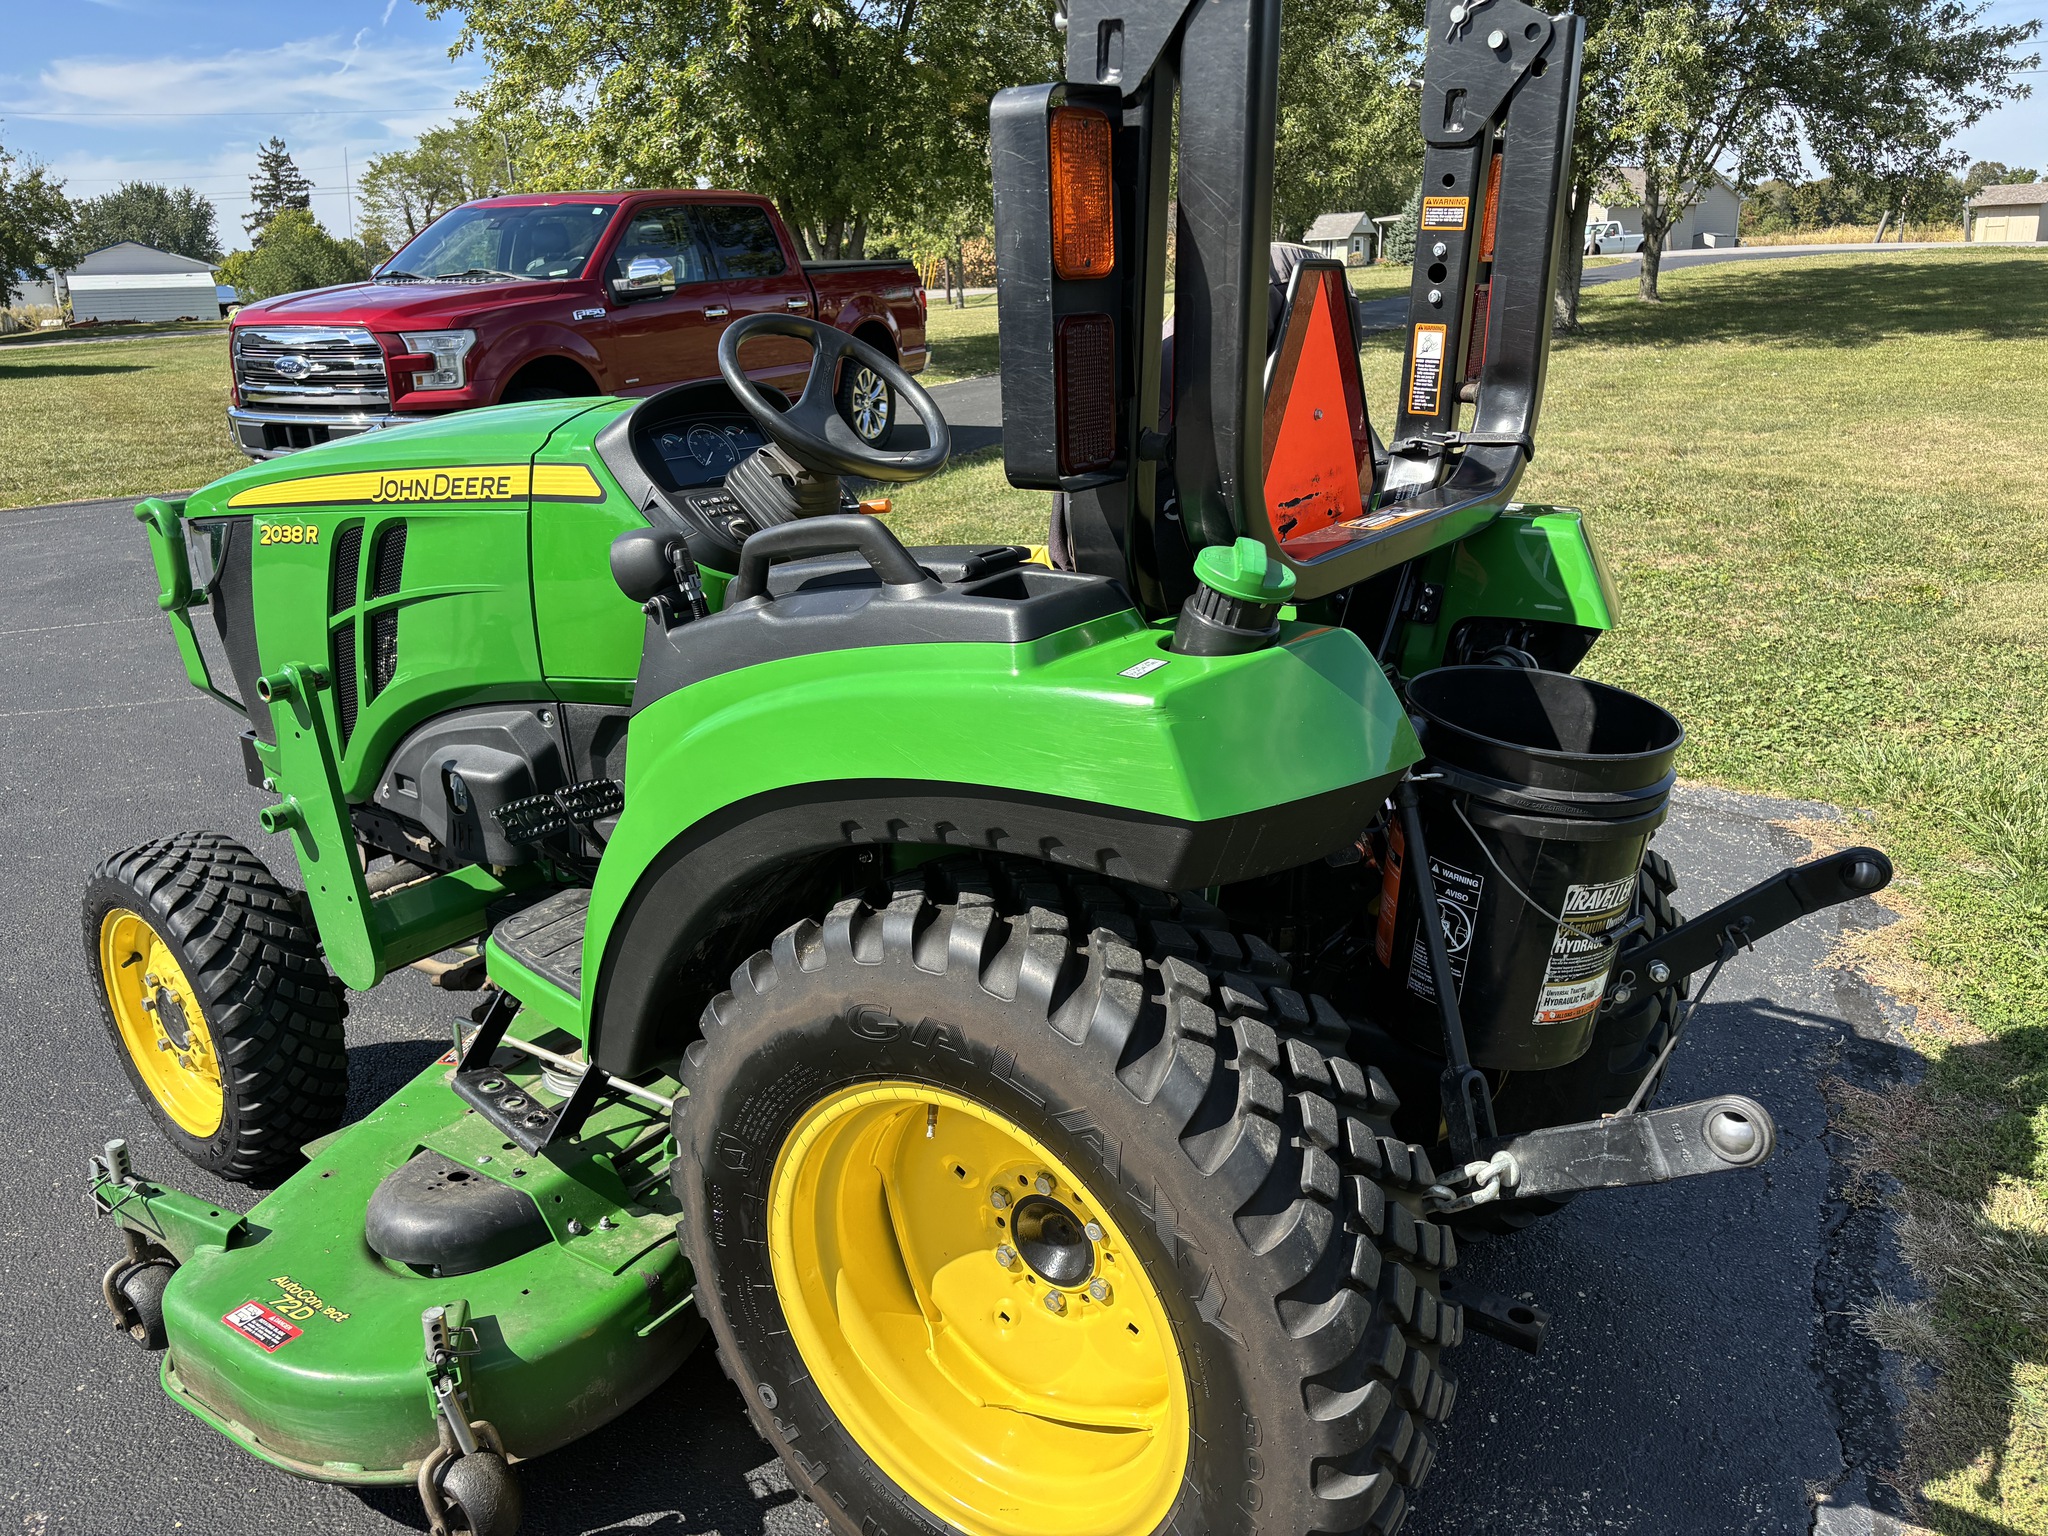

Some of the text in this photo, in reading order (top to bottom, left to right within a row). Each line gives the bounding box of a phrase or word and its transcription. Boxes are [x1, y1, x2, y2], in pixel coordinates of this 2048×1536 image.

[372, 473, 511, 499] JOHN DEERE
[1442, 868, 1479, 888] WARNING
[1445, 888, 1469, 902] AVISO
[1566, 877, 1635, 912] TRAVELLER
[1560, 920, 1607, 937] PREMIUM
[1554, 936, 1604, 954] HYDRAUL
[1546, 985, 1587, 997] UNIVERSAL TRACTOR
[1543, 996, 1580, 1007] HYDRAULIC
[845, 1003, 1249, 1352] GALAXY
[267, 1293, 315, 1321] 72D
[274, 1316, 293, 1331] DANGER
